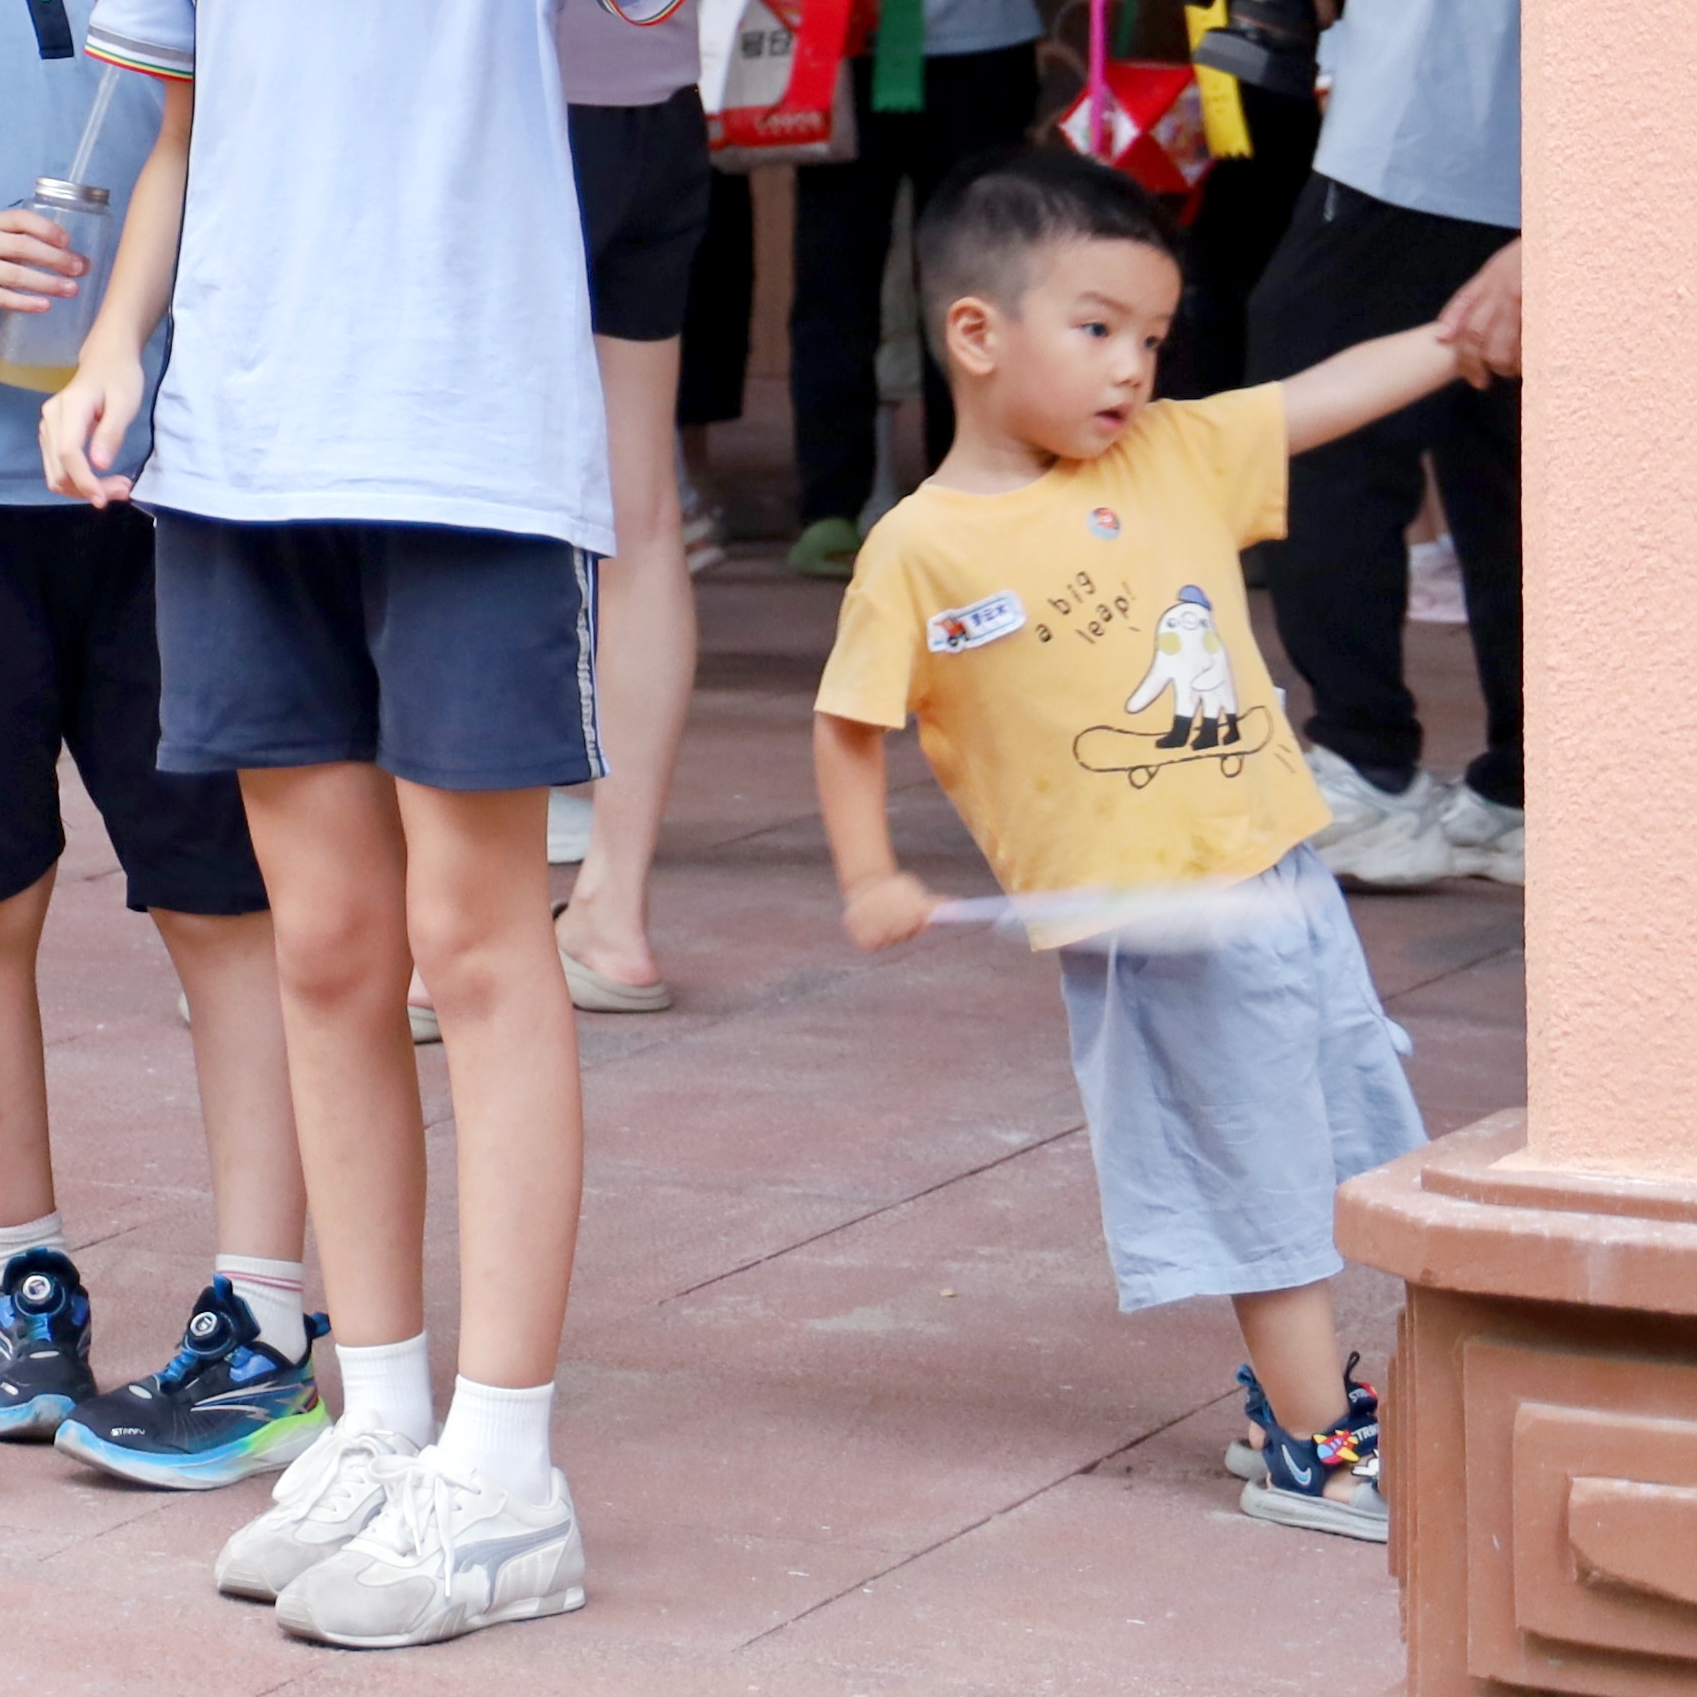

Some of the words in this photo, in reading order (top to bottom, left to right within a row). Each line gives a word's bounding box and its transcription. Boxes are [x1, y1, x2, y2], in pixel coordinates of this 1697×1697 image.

[1035, 623, 1053, 643] a
[1047, 570, 1096, 616] big
[1075, 581, 1136, 645] leap!
